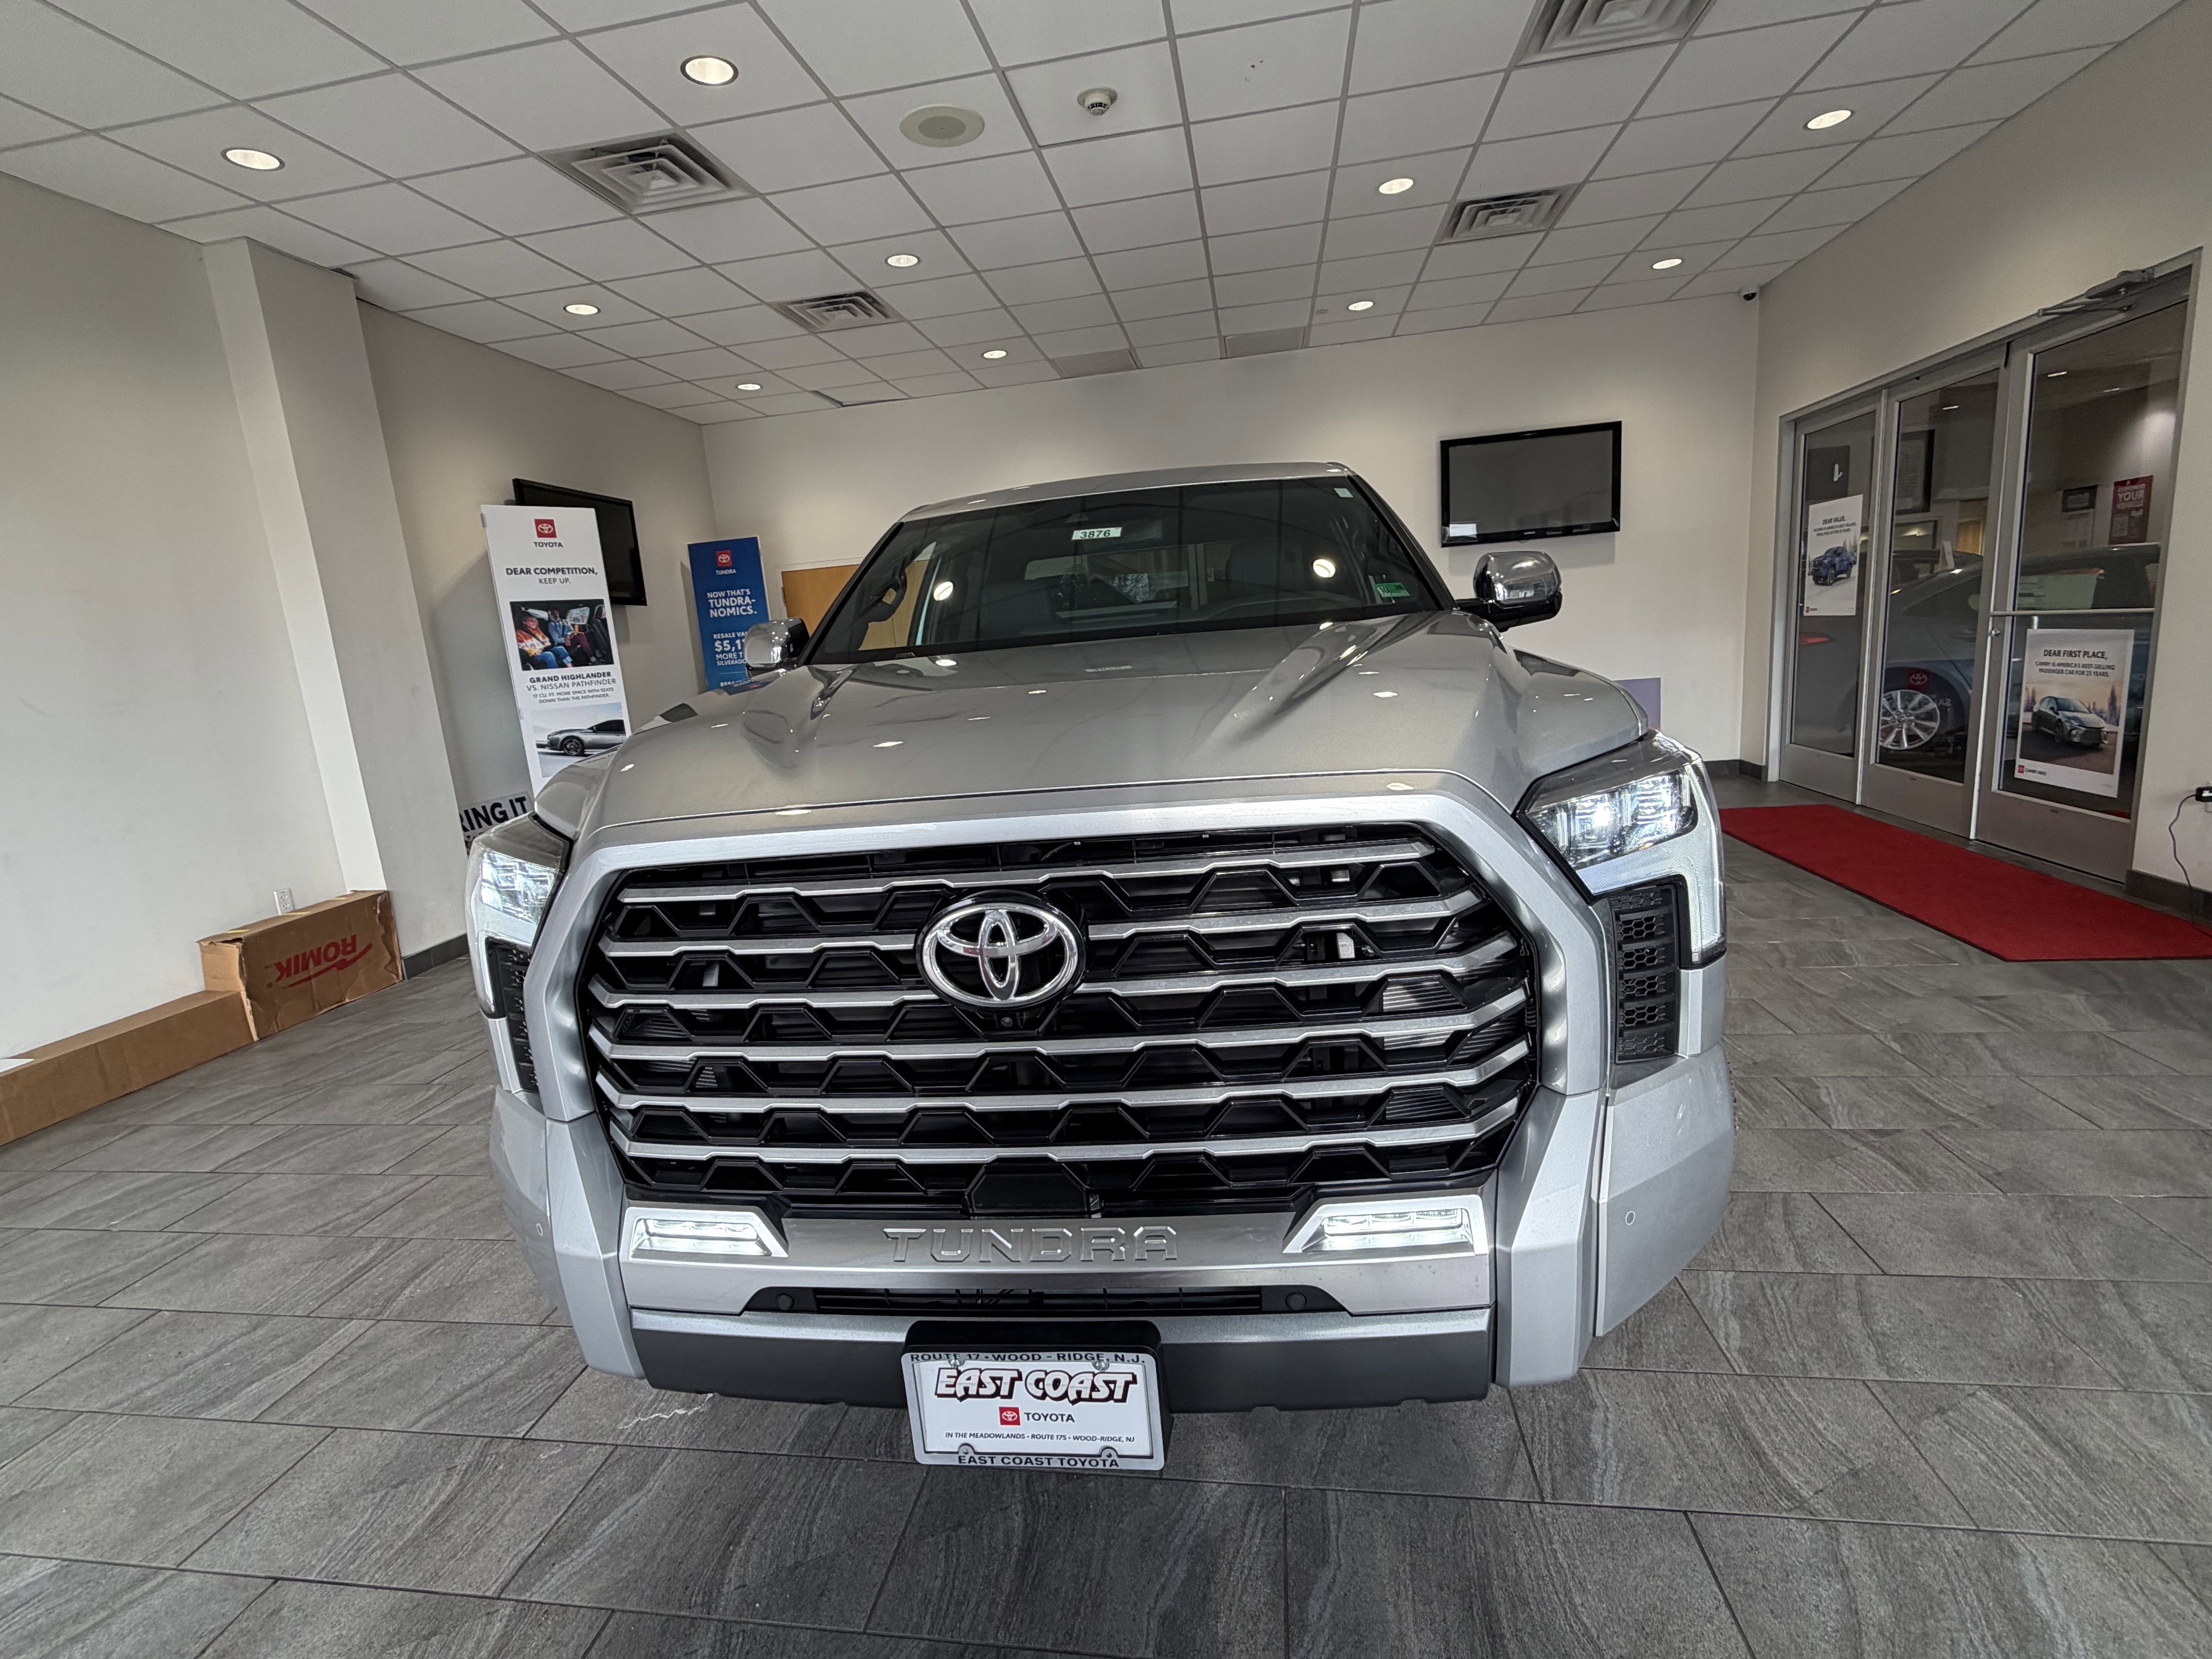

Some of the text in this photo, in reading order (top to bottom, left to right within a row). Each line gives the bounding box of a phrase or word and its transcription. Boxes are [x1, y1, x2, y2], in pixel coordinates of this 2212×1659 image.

[1080, 530, 1111, 539] 3876
[534, 567, 598, 575] COMPETITION,
[726, 588, 751, 597] THAT'S
[708, 596, 756, 608] TUNDRA-
[709, 605, 757, 618] NOMICS.
[716, 652, 738, 660] MORE
[2063, 650, 2081, 658] FIRST
[2083, 651, 2107, 660] PLACE,
[529, 672, 611, 683] GRAND HIGHLANDER
[541, 682, 570, 690] NISSAN
[572, 678, 617, 687] PATHFINDER
[509, 796, 527, 817] IT
[273, 934, 357, 983] ROMIK
[883, 1226, 1178, 1262] TUNDRA
[910, 1353, 962, 1362] ROUTE
[1056, 1353, 1109, 1363] RIDGE,
[1114, 1354, 1146, 1363] N.J.
[934, 1367, 1138, 1406] EAST COAST
[1024, 1412, 1075, 1423] TOYOTA
[958, 1455, 1119, 1467] EAST COAST TOYOTA
